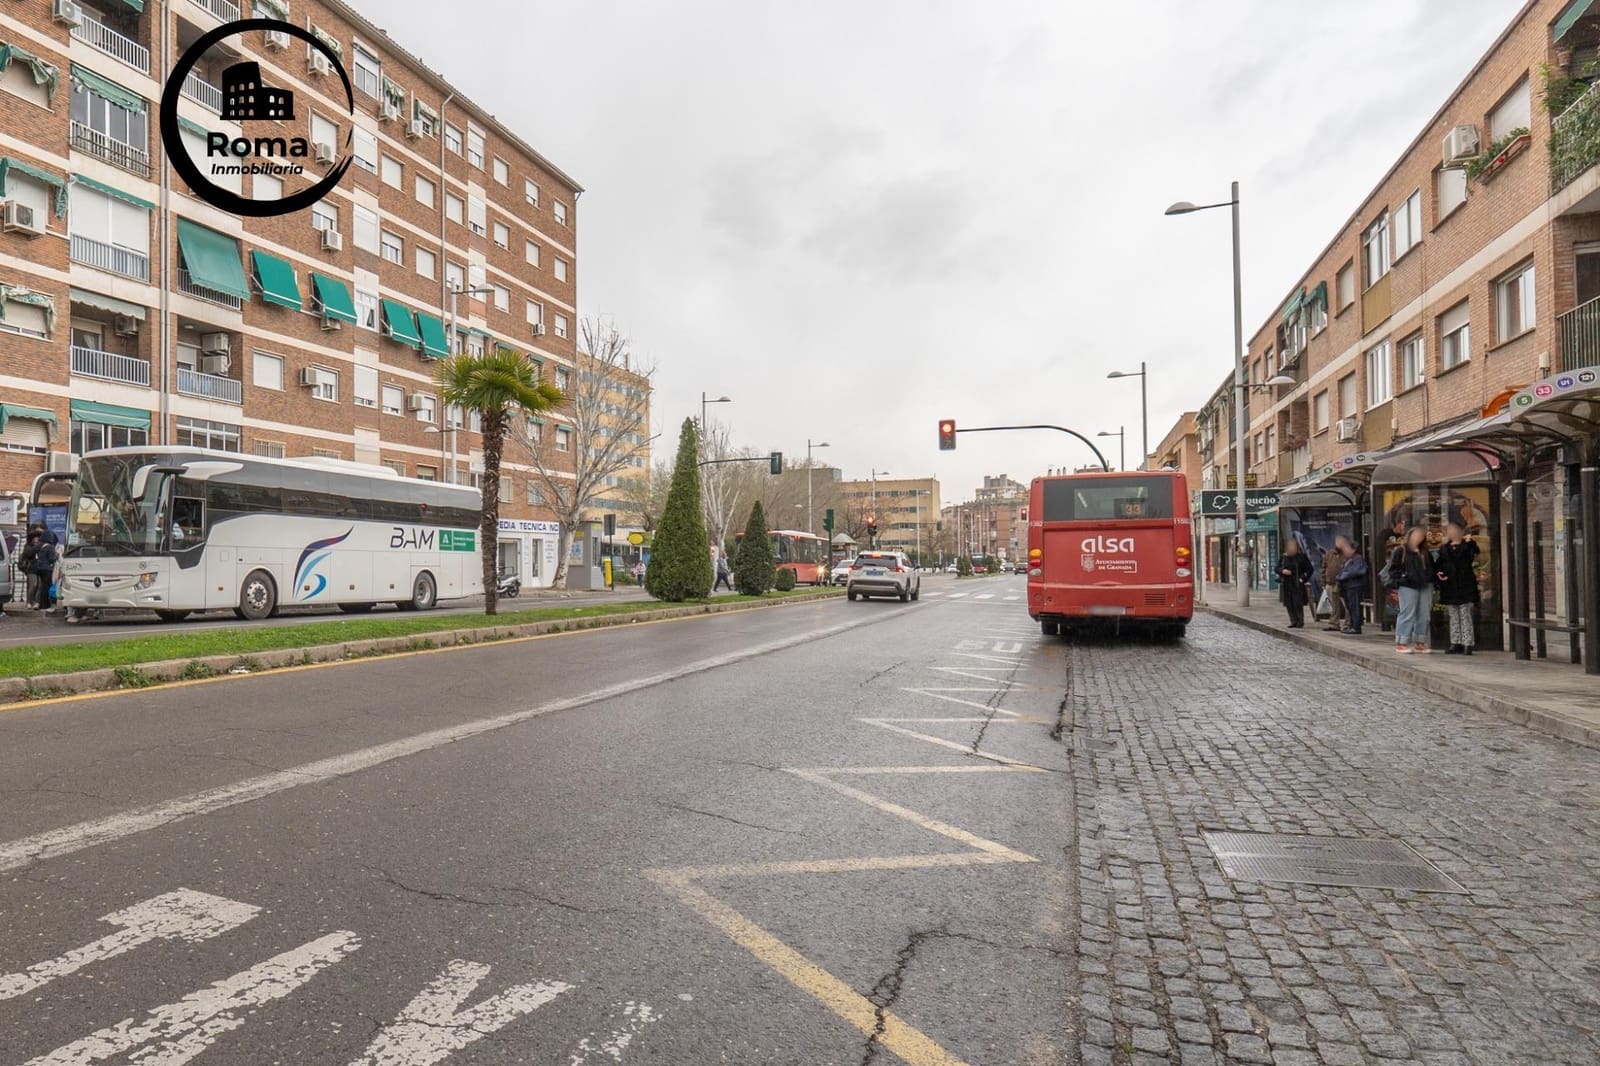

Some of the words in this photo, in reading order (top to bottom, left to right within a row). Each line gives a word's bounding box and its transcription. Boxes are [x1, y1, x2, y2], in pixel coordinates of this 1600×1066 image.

[1537, 387, 1551, 395] 33
[519, 522, 547, 531] TECNICA
[390, 527, 435, 551] BAM
[1081, 535, 1134, 553] alsa
